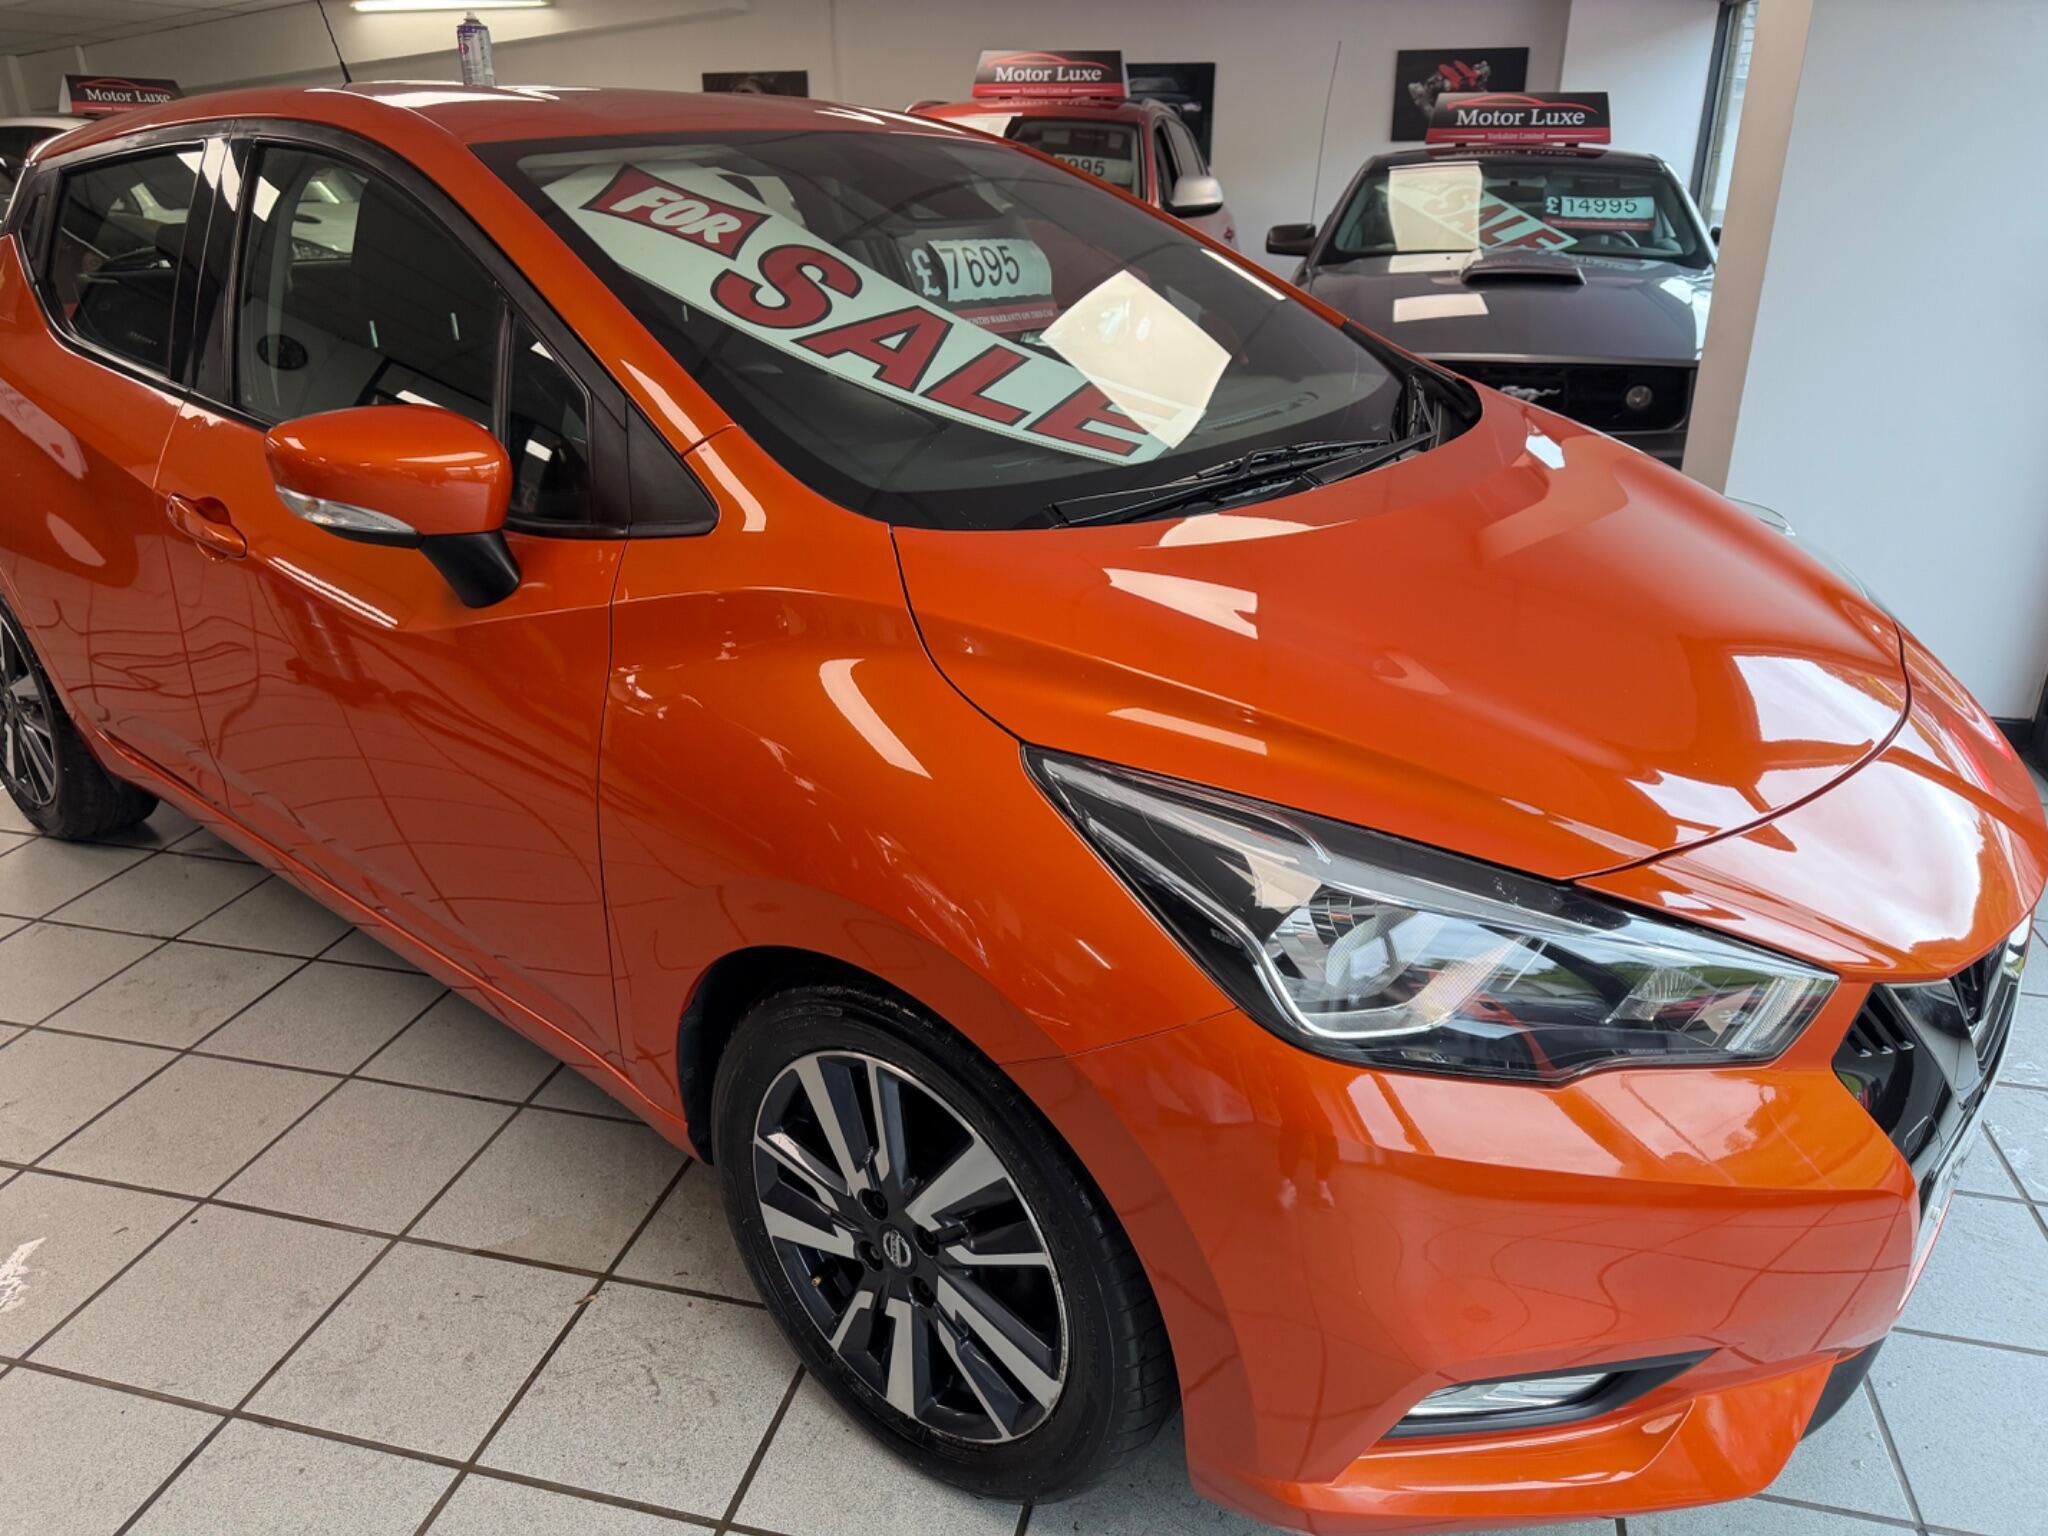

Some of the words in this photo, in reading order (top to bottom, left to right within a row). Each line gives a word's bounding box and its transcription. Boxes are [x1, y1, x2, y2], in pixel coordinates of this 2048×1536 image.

[994, 66, 1051, 82] Motor
[1056, 65, 1102, 81] Luxe
[85, 88, 132, 102] Motor
[134, 90, 170, 103] Luxe
[1456, 109, 1525, 126] Motor
[1530, 108, 1586, 125] Luxe
[609, 186, 743, 244] FOR
[710, 244, 1180, 457] SALE
